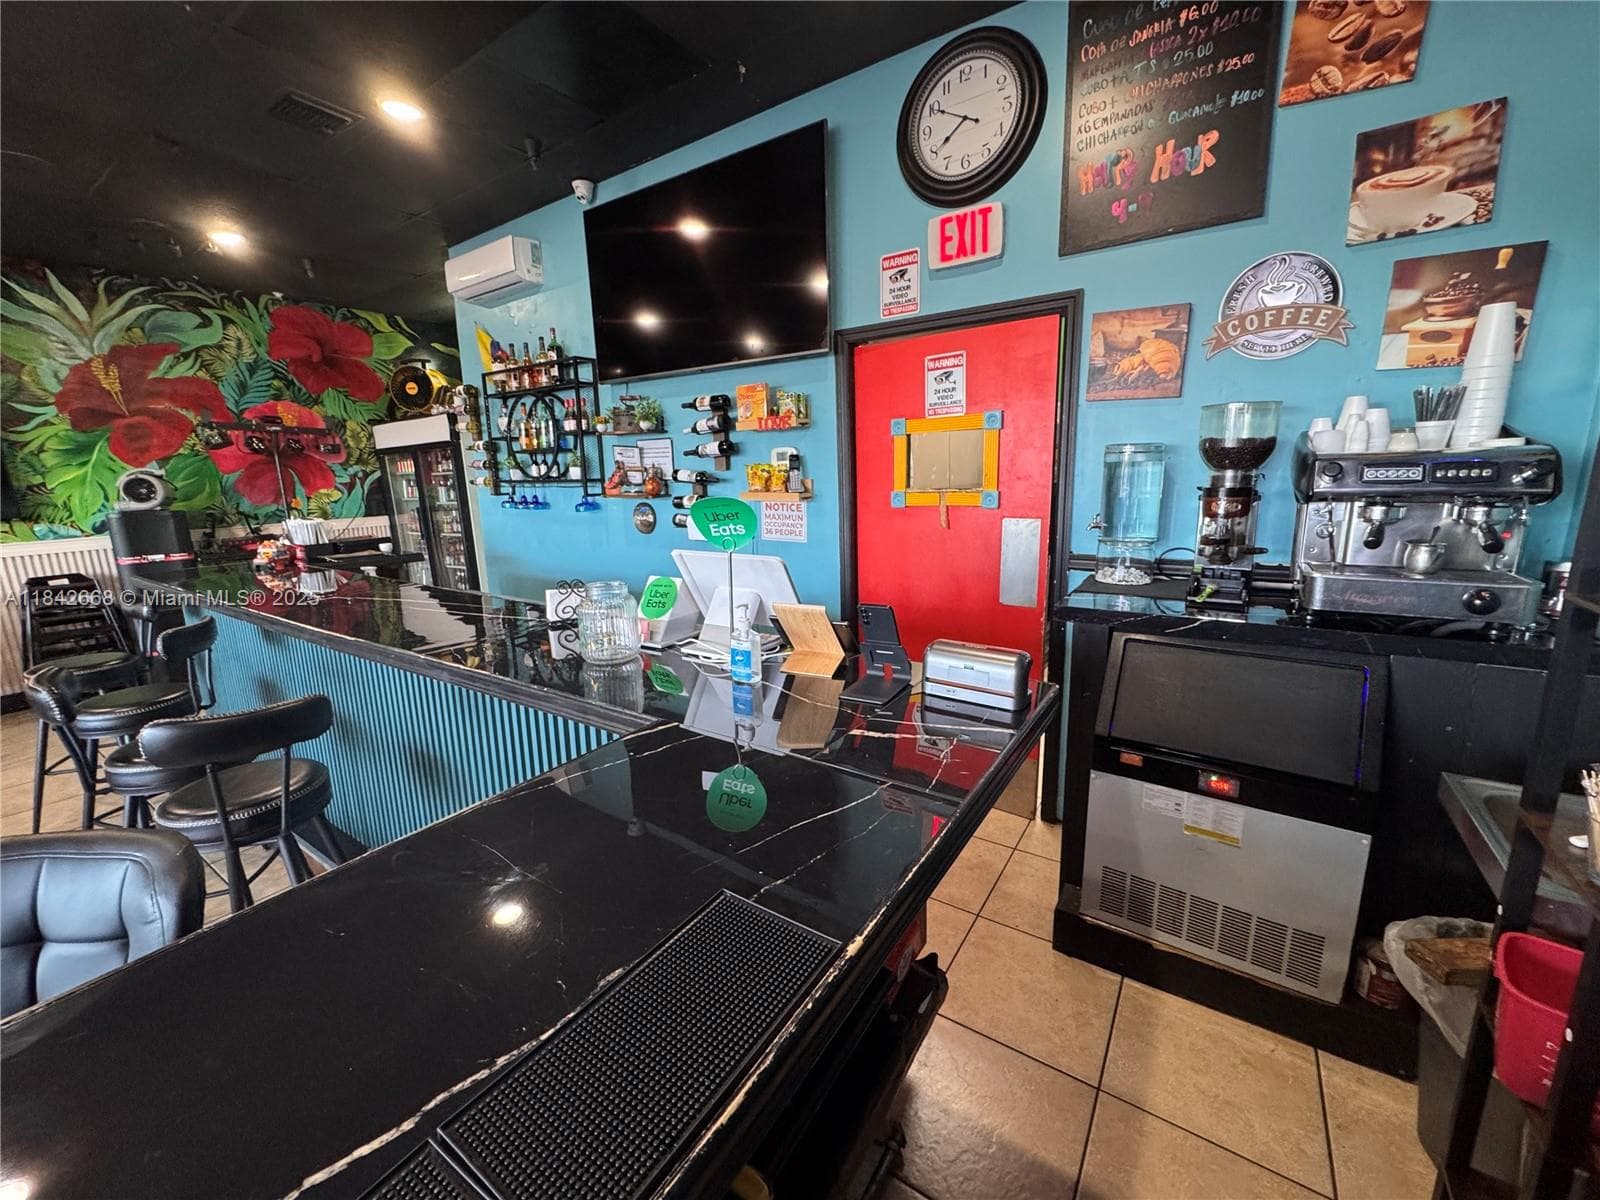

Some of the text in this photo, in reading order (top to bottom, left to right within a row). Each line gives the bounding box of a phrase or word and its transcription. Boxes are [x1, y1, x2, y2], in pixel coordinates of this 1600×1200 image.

[959, 64, 972, 84] 12
[942, 79, 950, 95] 11
[996, 74, 1007, 92] 2
[928, 99, 941, 117] 10
[1001, 95, 1013, 112] 3
[922, 125, 932, 141] 9
[994, 122, 1006, 137] 4
[929, 144, 939, 161] 8
[981, 142, 992, 158] 5
[943, 154, 953, 171] 7
[960, 153, 971, 170] 6
[940, 206, 992, 263] EXIT
[882, 252, 918, 269] WARNING
[1302, 260, 1335, 303] BREWED
[892, 292, 908, 300] VIDEO
[1226, 273, 1257, 314] FRESH
[1226, 307, 1333, 337] COFFEE
[928, 356, 963, 370] WARNING
[765, 502, 803, 512] NOTICE
[704, 511, 740, 523] Uber
[764, 521, 804, 529] OCCUPANCY
[709, 523, 746, 537] Eats
[775, 529, 803, 537] PEOPLE
[649, 589, 670, 599] Uber
[646, 599, 667, 609] Eats
